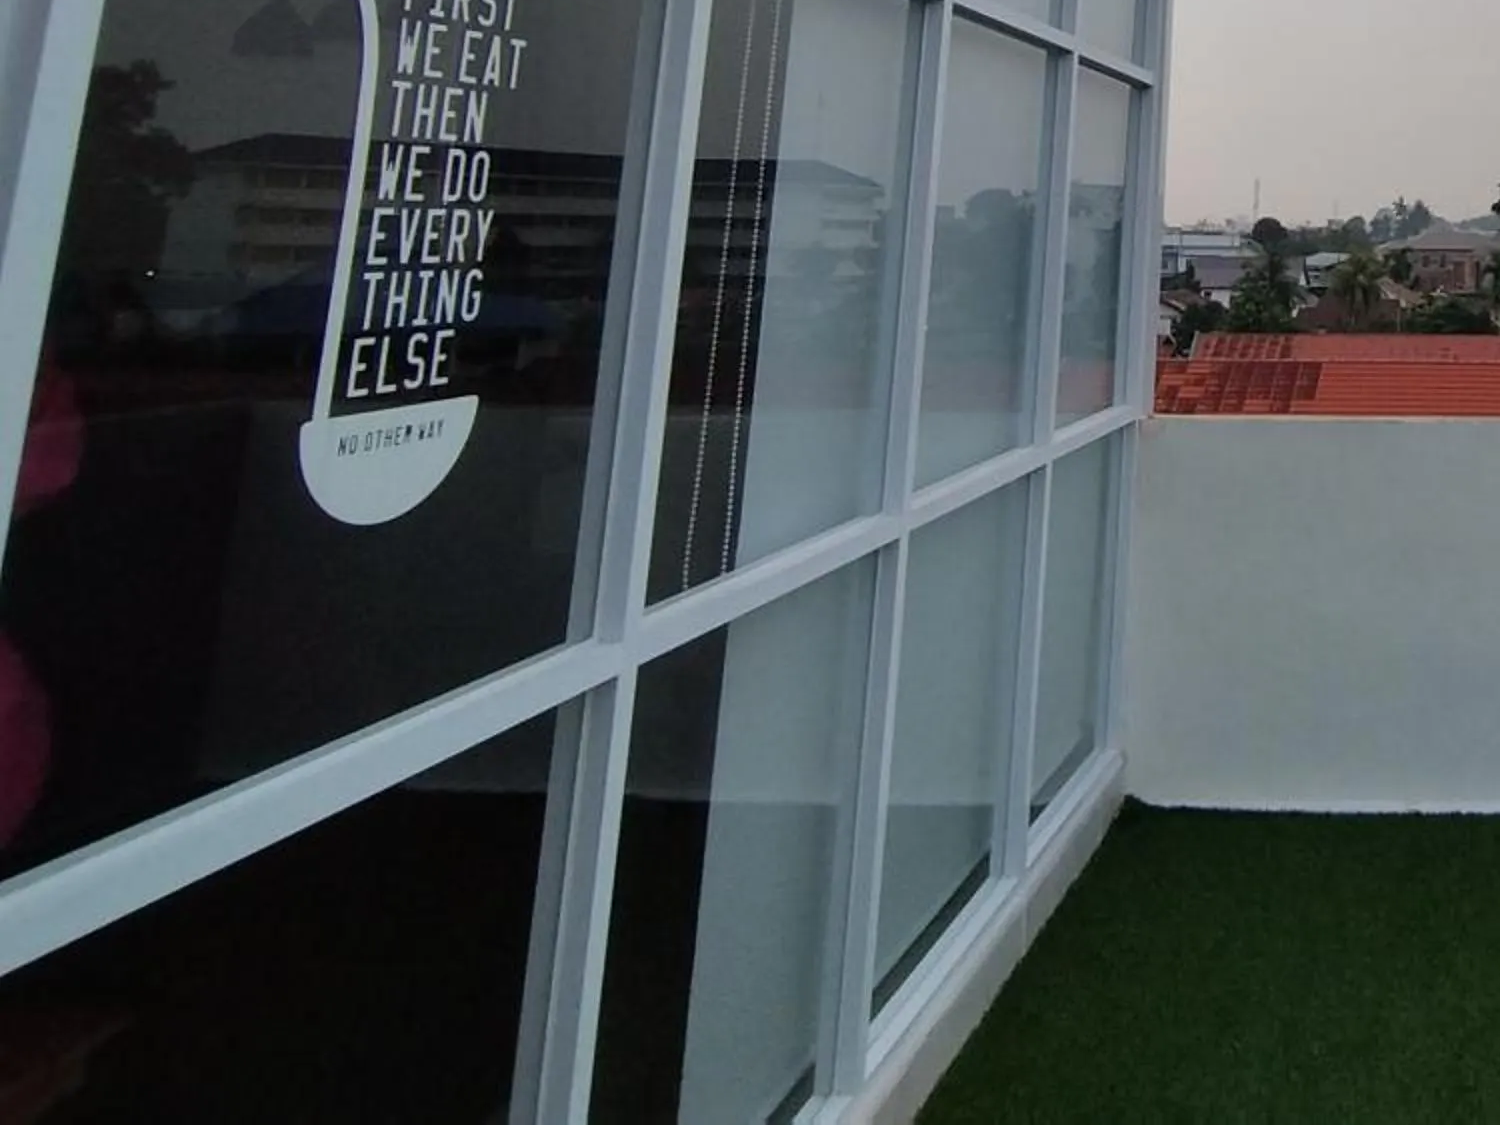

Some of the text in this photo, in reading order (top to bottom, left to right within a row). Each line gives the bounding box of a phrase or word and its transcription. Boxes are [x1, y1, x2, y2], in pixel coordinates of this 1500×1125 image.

[397, 17, 527, 89] WE EAT
[391, 81, 488, 143] THEN
[378, 143, 490, 203] WE DO
[365, 207, 495, 266] EVERY
[363, 269, 483, 331] THING
[346, 329, 456, 398] ELSE
[337, 434, 359, 456] NO
[418, 419, 445, 441] WAY
